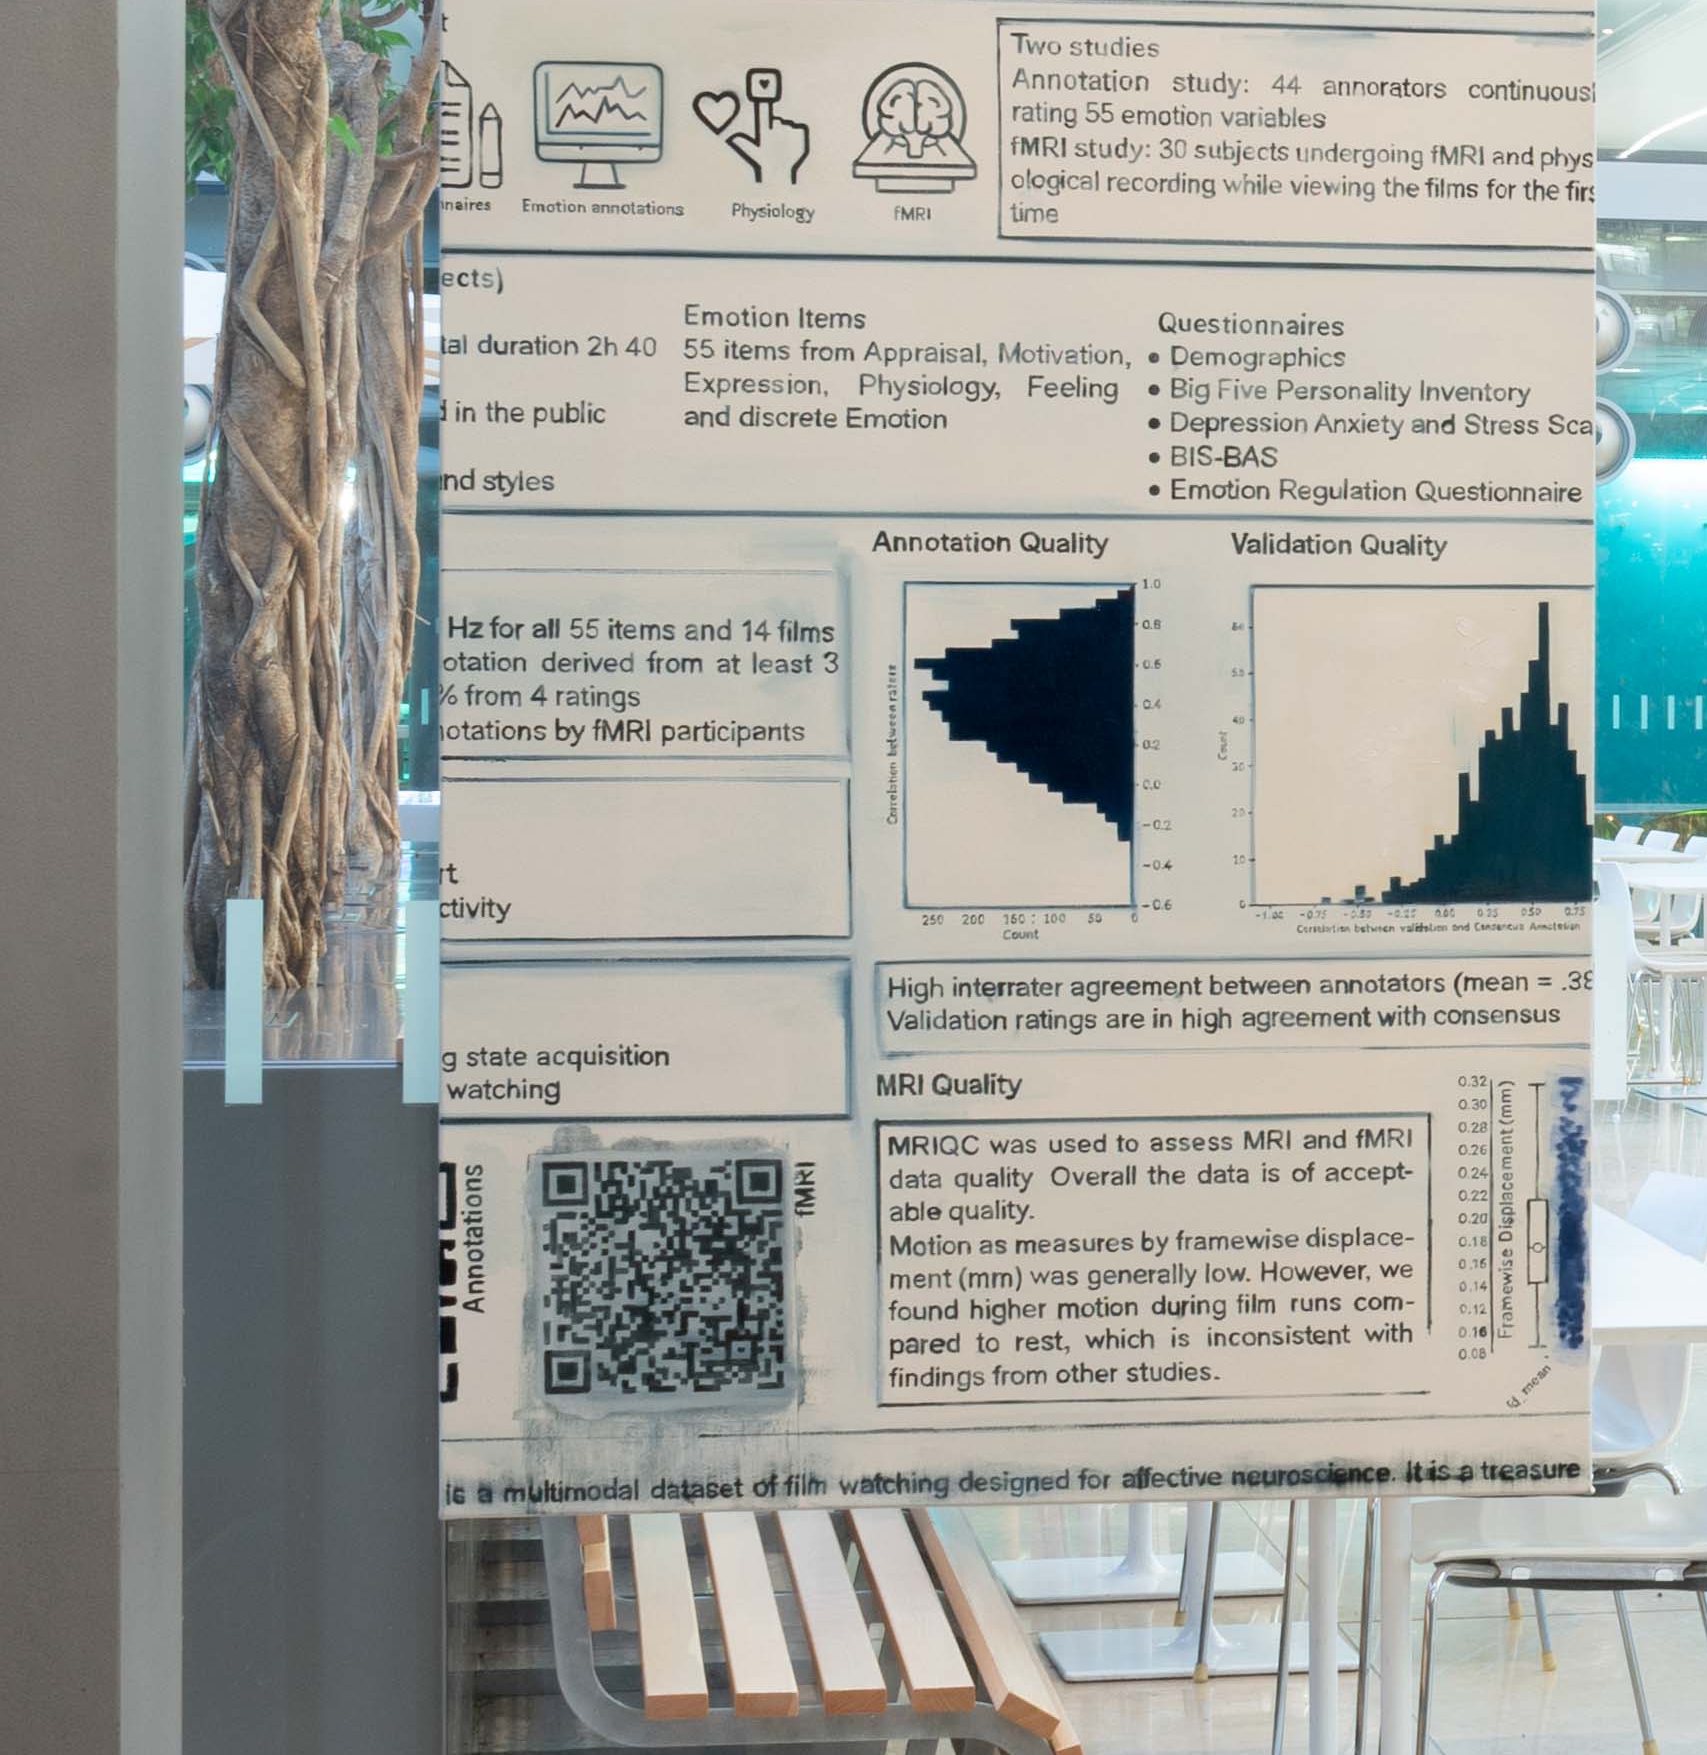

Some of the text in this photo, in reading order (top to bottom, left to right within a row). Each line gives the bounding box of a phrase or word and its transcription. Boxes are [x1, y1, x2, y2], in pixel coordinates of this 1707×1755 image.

[1009, 32, 1159, 58] Two studies
[1012, 101, 1327, 129] rating 55 emotion variables
[522, 198, 685, 217] Emotion annotations
[731, 202, 815, 224] Physiology
[894, 206, 931, 221] fMRI
[684, 303, 867, 330] Emotion Items
[1157, 311, 1345, 337] Questionnaires
[1170, 345, 1346, 373] Demographics
[1170, 377, 1532, 409] Big Five Personality Inventory
[1171, 444, 1278, 468] BIS-BAS
[1170, 478, 1583, 507] Emotion Regulation Questionnaire
[871, 530, 1109, 560] Annotation Quality
[1230, 532, 1448, 562] Validation Quality
[888, 973, 1446, 1005] High interrater agreement between annotators
[877, 1072, 1023, 1101] MRI Quality
[888, 1127, 1412, 1157] MRIQC was used to assess MRI and fMRI
[794, 1162, 815, 1217] fMRI
[460, 1164, 485, 1314] Annotations
